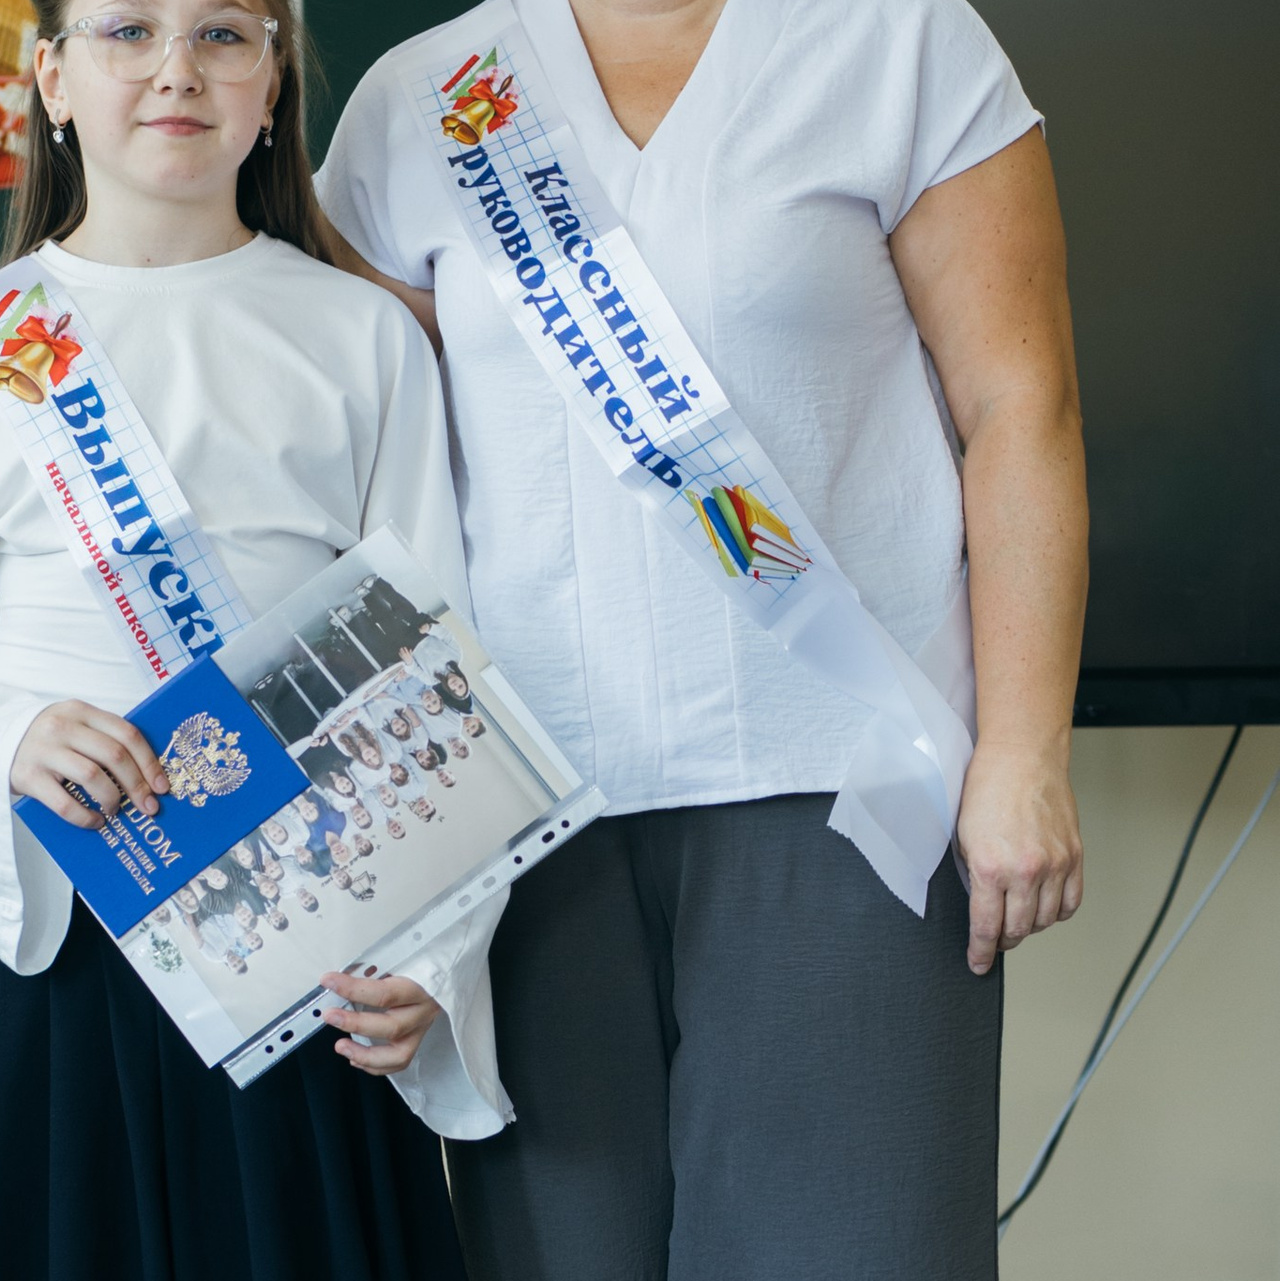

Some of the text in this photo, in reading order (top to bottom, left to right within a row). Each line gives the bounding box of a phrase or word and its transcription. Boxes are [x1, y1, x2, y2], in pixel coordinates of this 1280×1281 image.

[448, 145, 684, 490] руководитель
[523, 161, 700, 424] Классный
[45, 461, 170, 681] начальной школы
[116, 848, 156, 896] ШКОЛЫ
